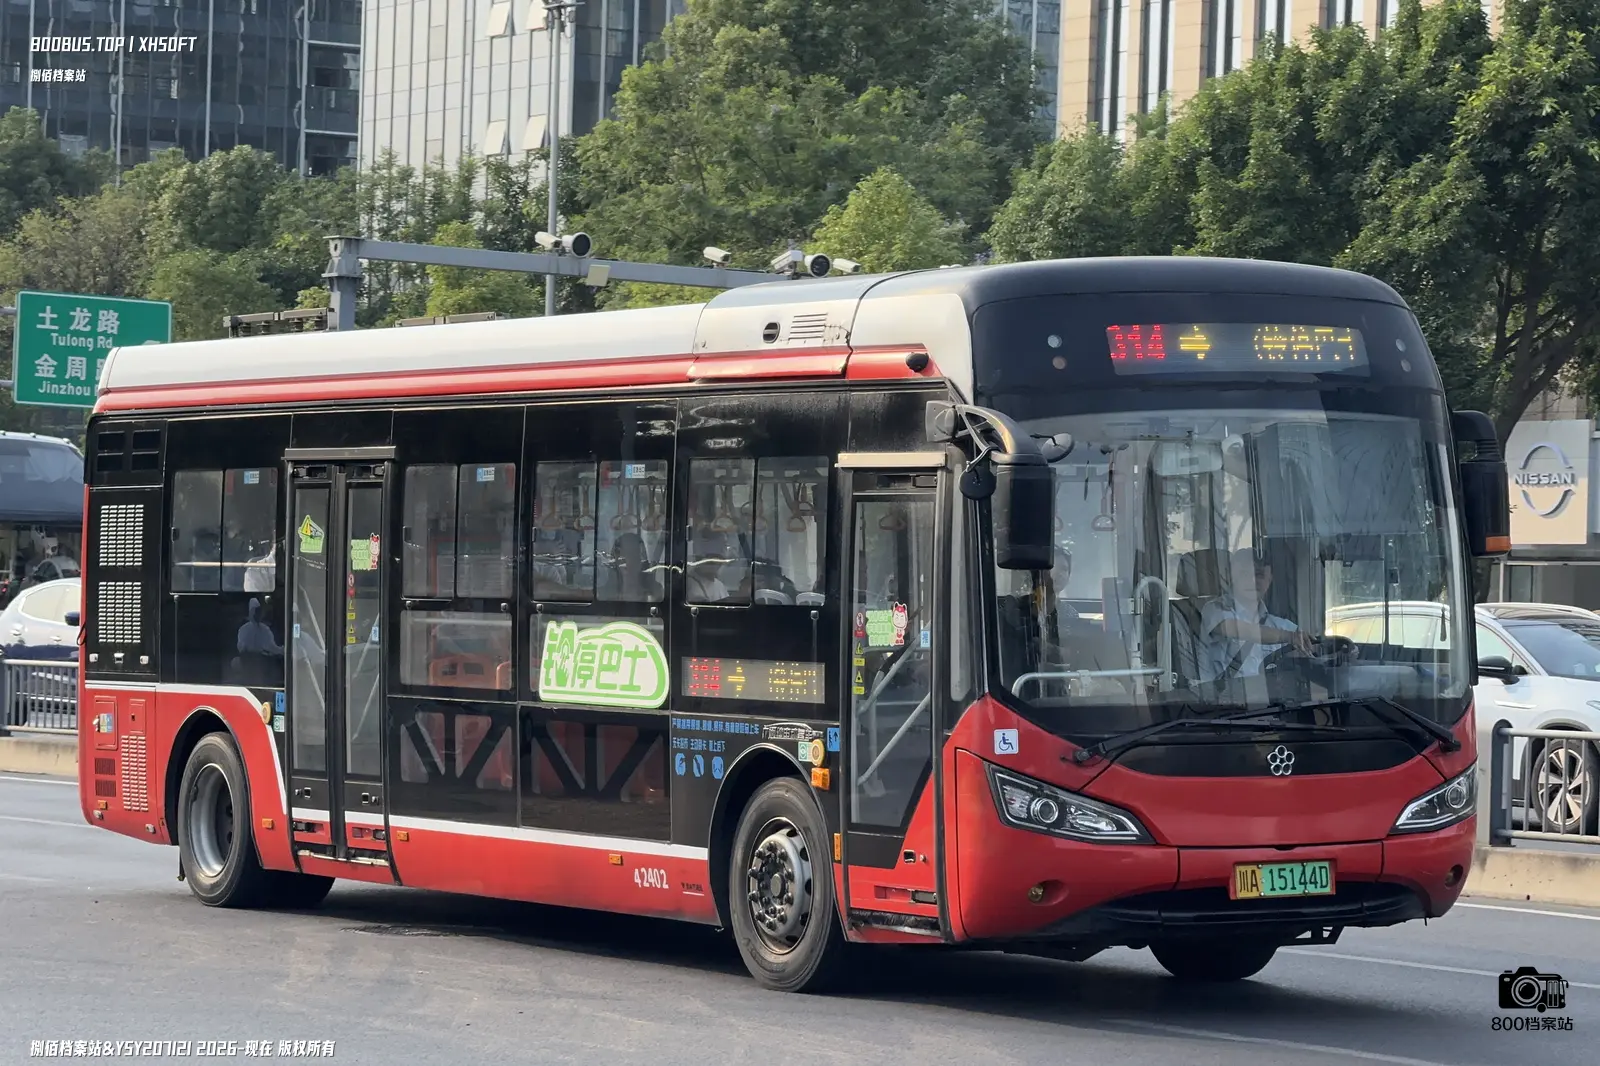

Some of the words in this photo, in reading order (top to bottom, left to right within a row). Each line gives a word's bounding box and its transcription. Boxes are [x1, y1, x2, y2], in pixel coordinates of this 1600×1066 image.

[36, 305, 120, 335] 土龙路
[51, 333, 94, 351] Tulong
[38, 381, 91, 397] Jinzhou
[1514, 473, 1574, 486] NISSAN
[634, 867, 669, 889] 42402
[1239, 869, 1260, 893] 川A
[1268, 865, 1329, 892] 15144D
